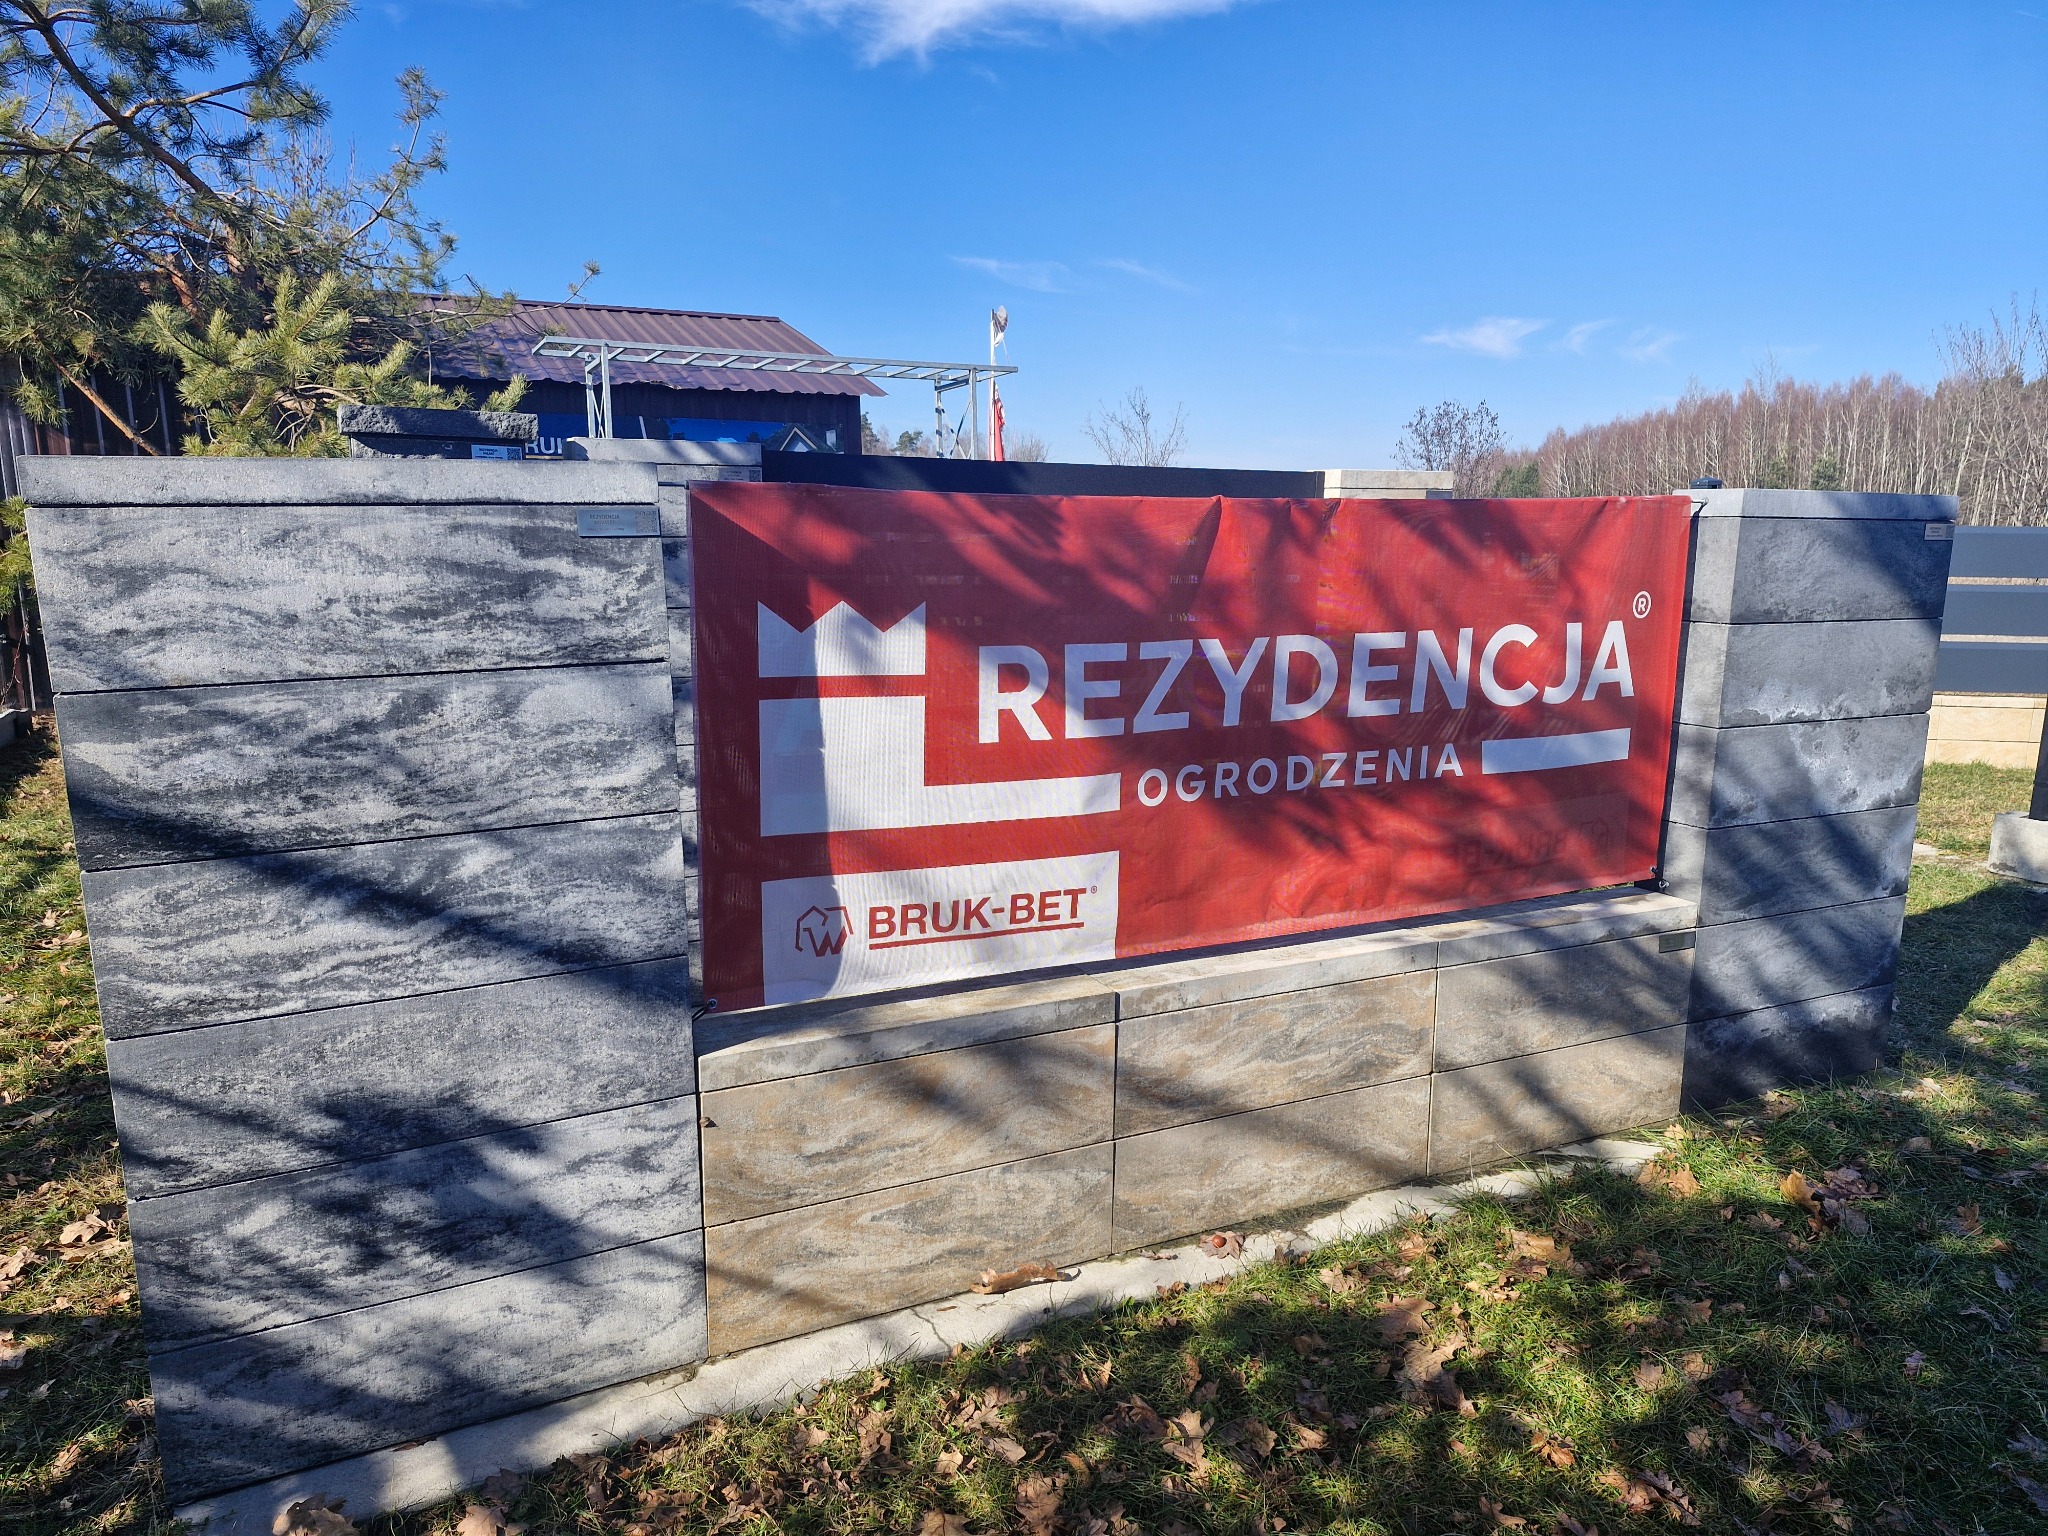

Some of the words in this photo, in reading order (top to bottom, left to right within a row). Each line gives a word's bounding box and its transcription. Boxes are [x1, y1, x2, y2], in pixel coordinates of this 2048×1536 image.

[978, 620, 1635, 744] REZYDENCJA
[1137, 742, 1464, 807] OGRODZENIA
[868, 887, 1088, 940] BRUK-BET
